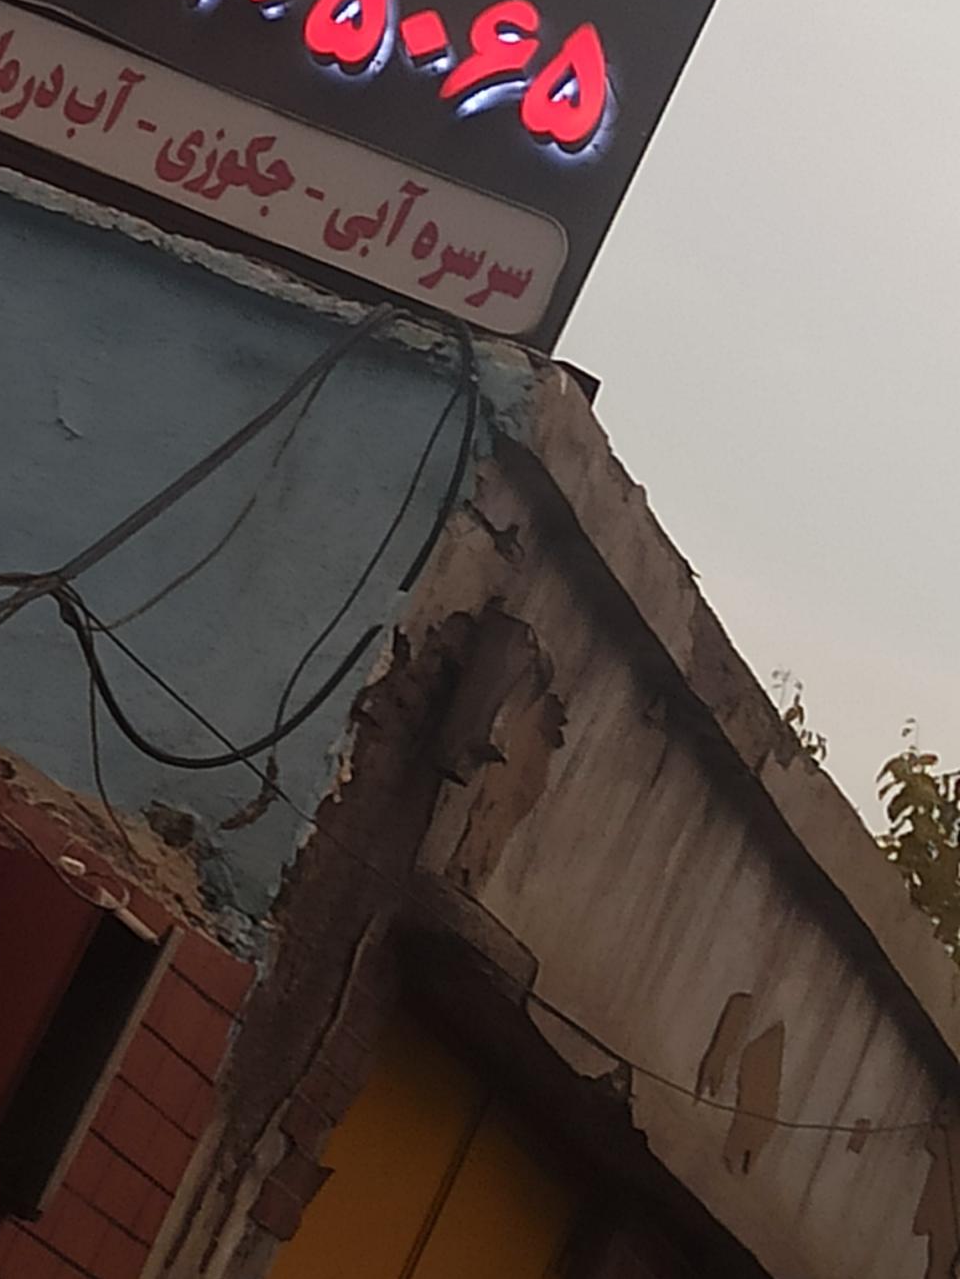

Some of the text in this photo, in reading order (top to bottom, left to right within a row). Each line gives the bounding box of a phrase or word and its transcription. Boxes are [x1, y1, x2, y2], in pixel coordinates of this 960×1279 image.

[61, 68, 145, 141] آب
[153, 127, 295, 218] جکوزی
[323, 182, 427, 257] آبی
[411, 220, 533, 307] سرسره
